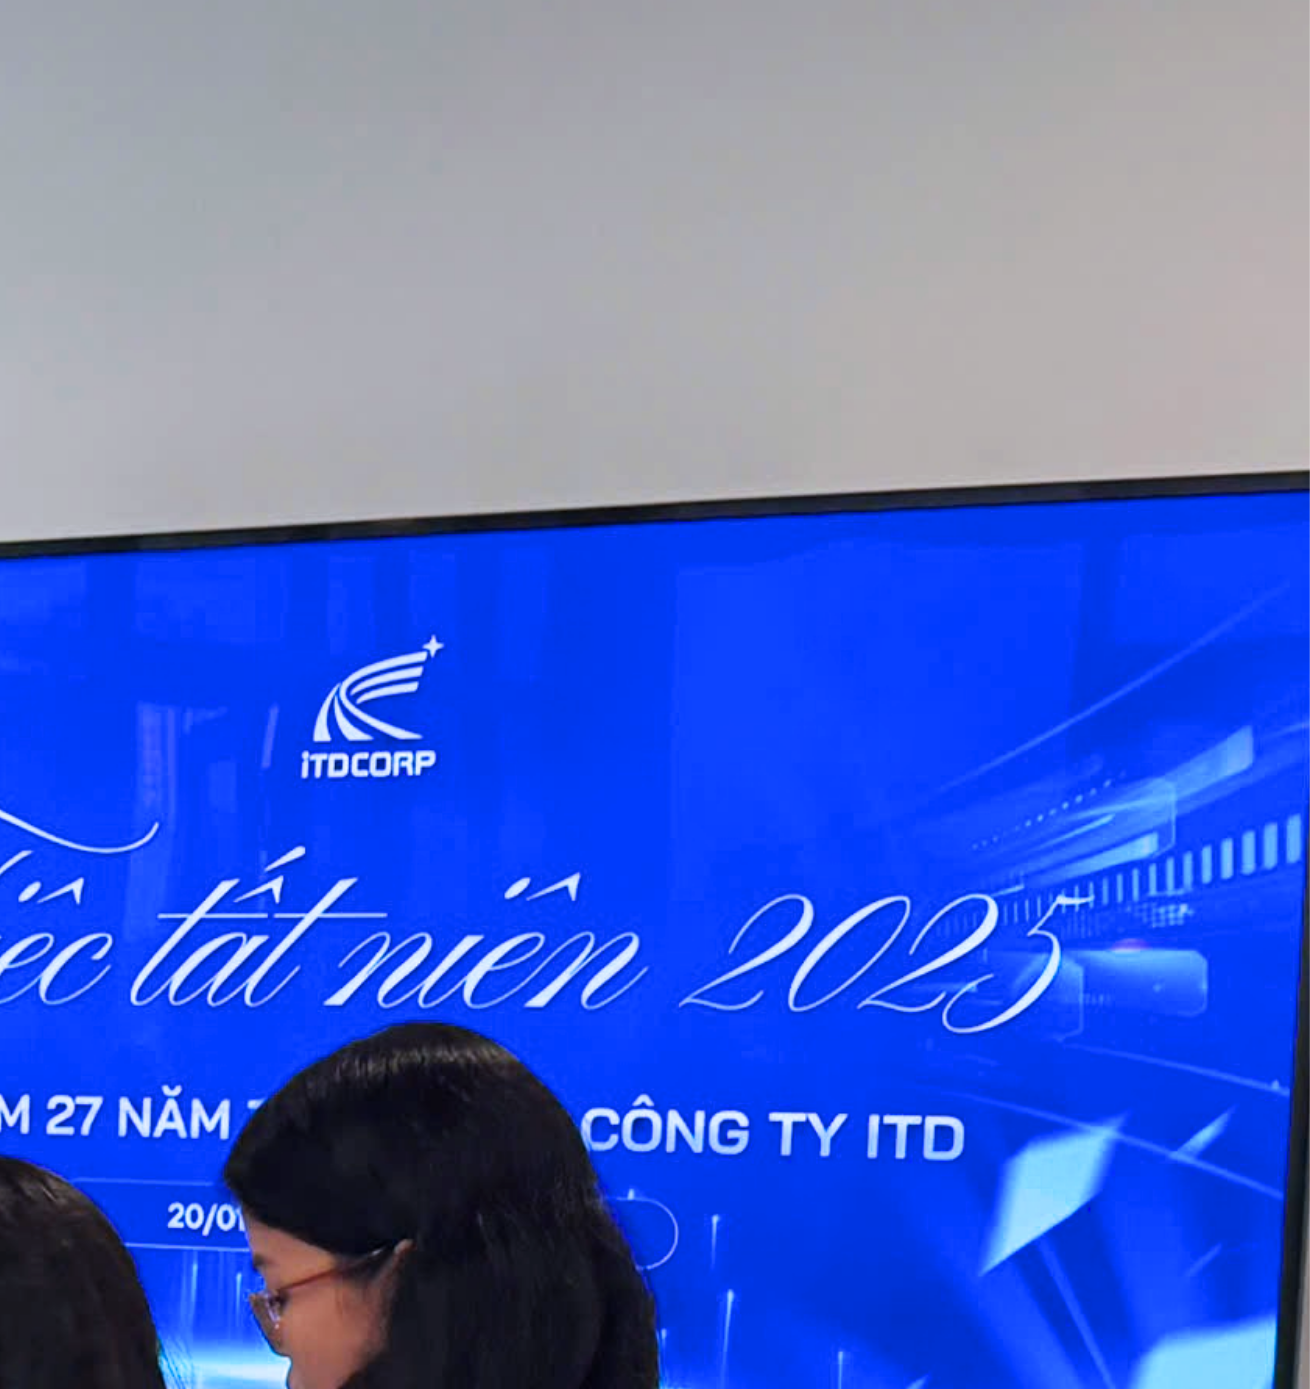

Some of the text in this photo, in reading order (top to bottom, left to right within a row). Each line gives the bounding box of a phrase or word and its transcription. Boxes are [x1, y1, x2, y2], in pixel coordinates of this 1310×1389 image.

[129, 845, 388, 1008] tất
[323, 873, 649, 1011] niên
[678, 893, 1093, 1035] 2025
[46, 1094, 104, 1137] 27
[118, 1084, 231, 1140] NĂM
[582, 1093, 750, 1156] CÔNG
[768, 1111, 849, 1157] TY
[866, 1113, 966, 1161] ITD
